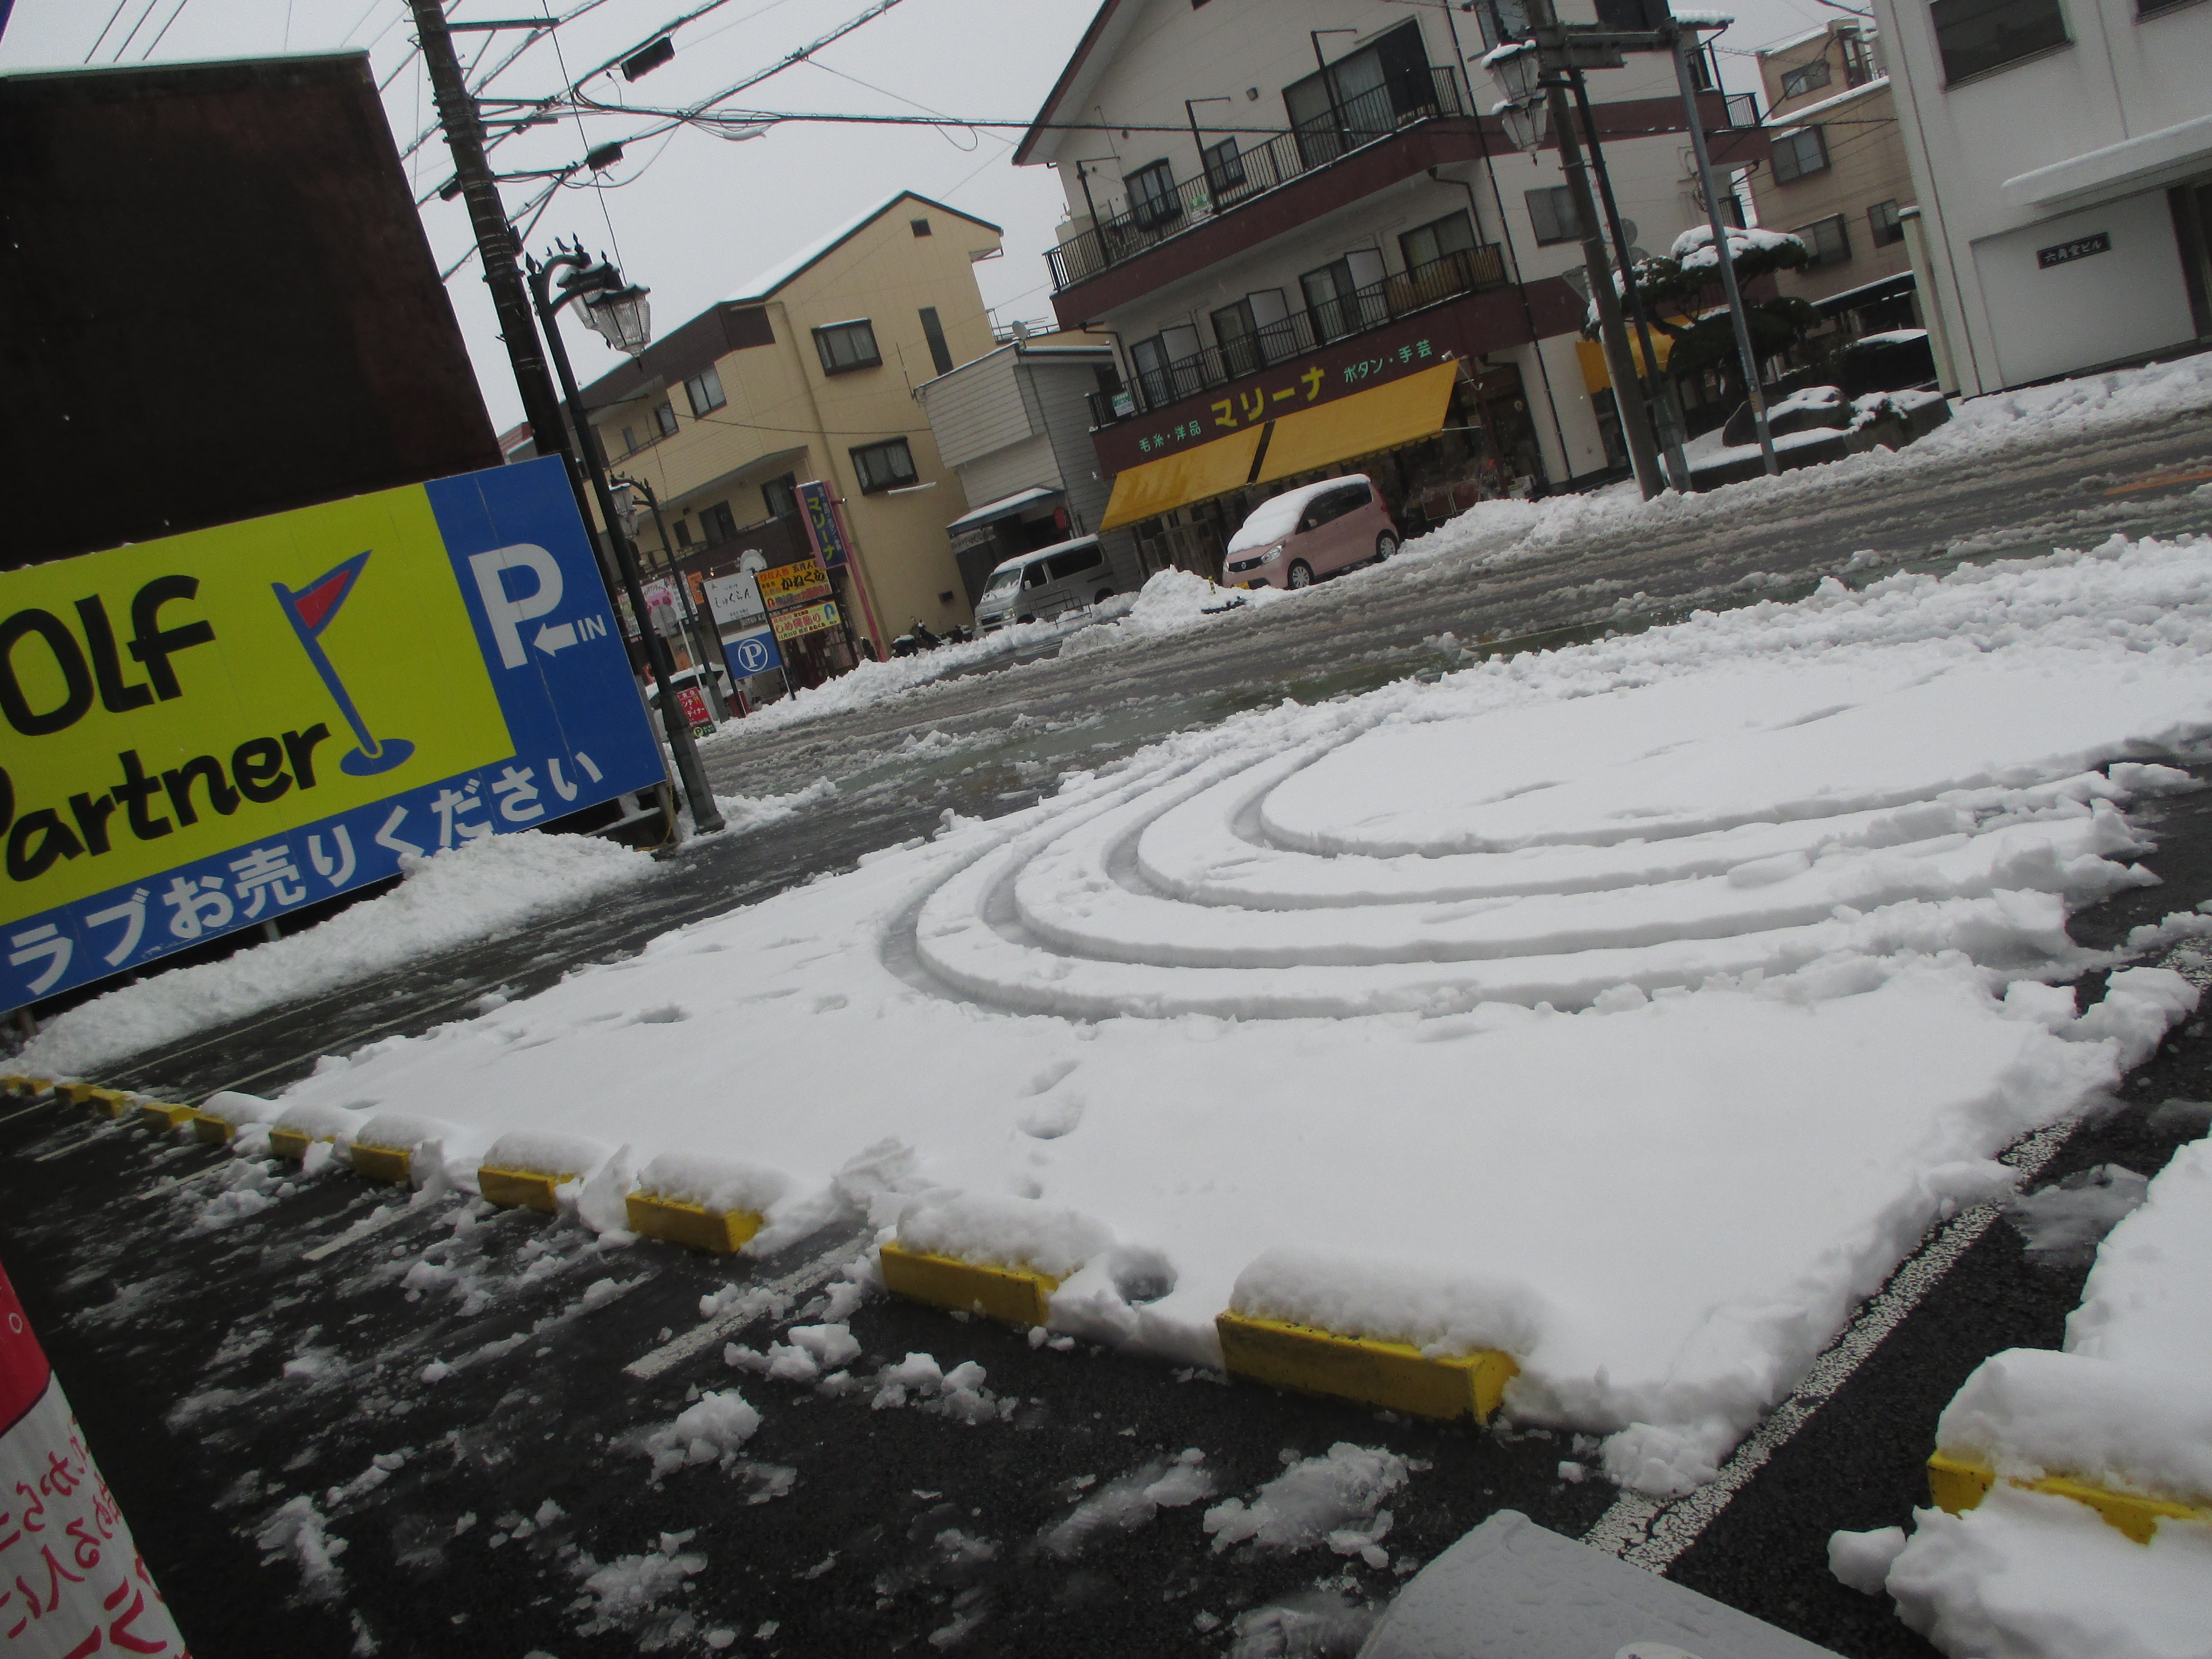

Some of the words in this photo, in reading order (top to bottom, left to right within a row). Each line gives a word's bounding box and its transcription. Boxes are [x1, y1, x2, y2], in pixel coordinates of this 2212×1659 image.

[1211, 366, 1325, 427] マリーナ
[1344, 339, 1433, 383] ボタン・手芸
[807, 496, 835, 561] マリーナ
[468, 543, 564, 670] P
[577, 614, 607, 641] IN
[714, 588, 752, 608] しゅくらん
[742, 644, 762, 668] P
[9, 751, 603, 996] ラブお売りください
